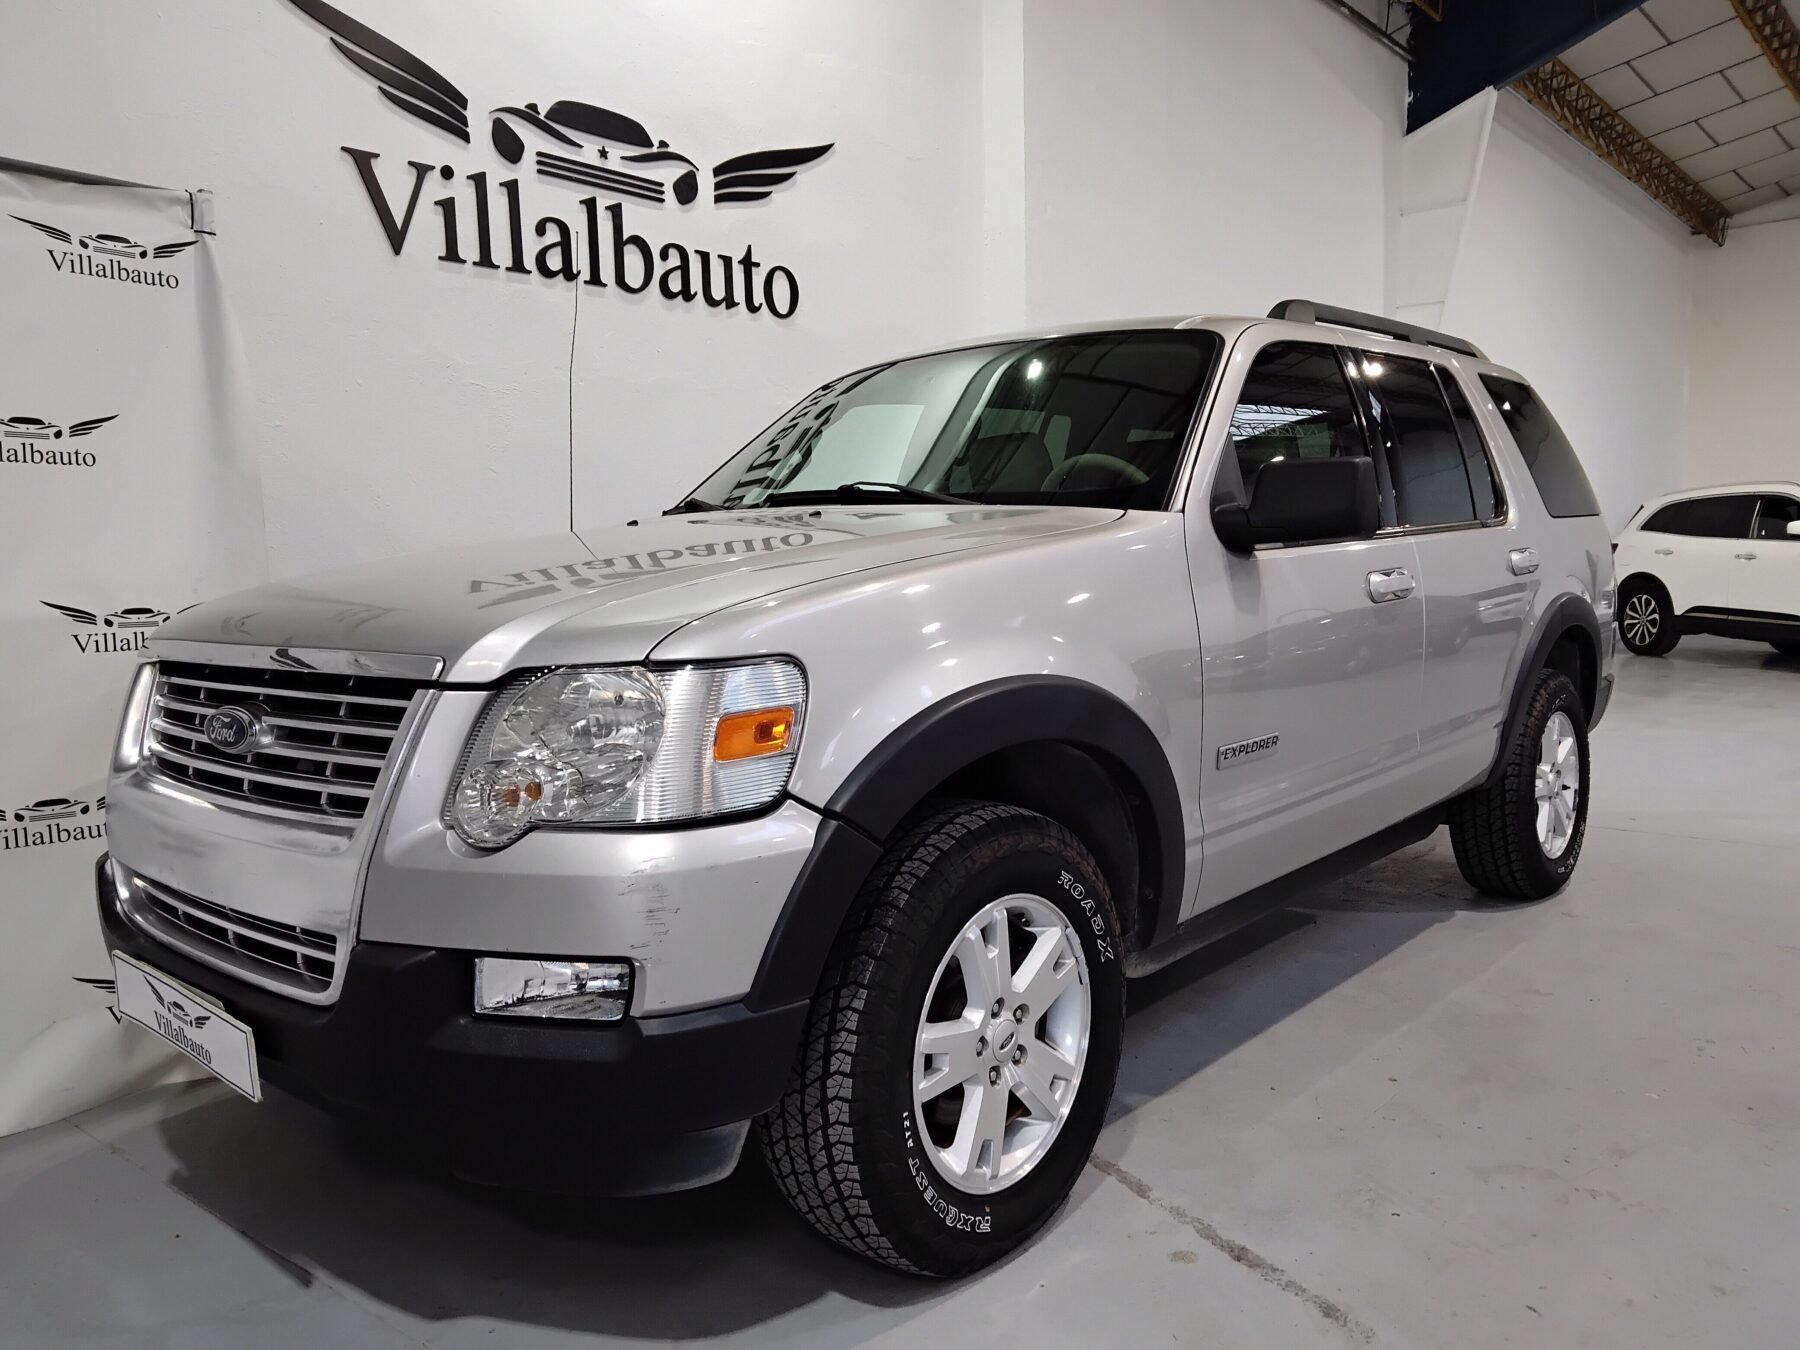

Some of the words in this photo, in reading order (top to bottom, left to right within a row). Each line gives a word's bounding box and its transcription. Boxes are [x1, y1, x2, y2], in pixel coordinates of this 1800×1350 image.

[340, 145, 800, 320] Villalbauto
[46, 248, 179, 289] Villalbauto
[209, 715, 238, 742] Ford
[1223, 735, 1280, 760] EXPLORER
[1057, 870, 1114, 963] ROADX
[153, 1010, 212, 1065] Villalbauto
[908, 1157, 991, 1232] RXQUEST
